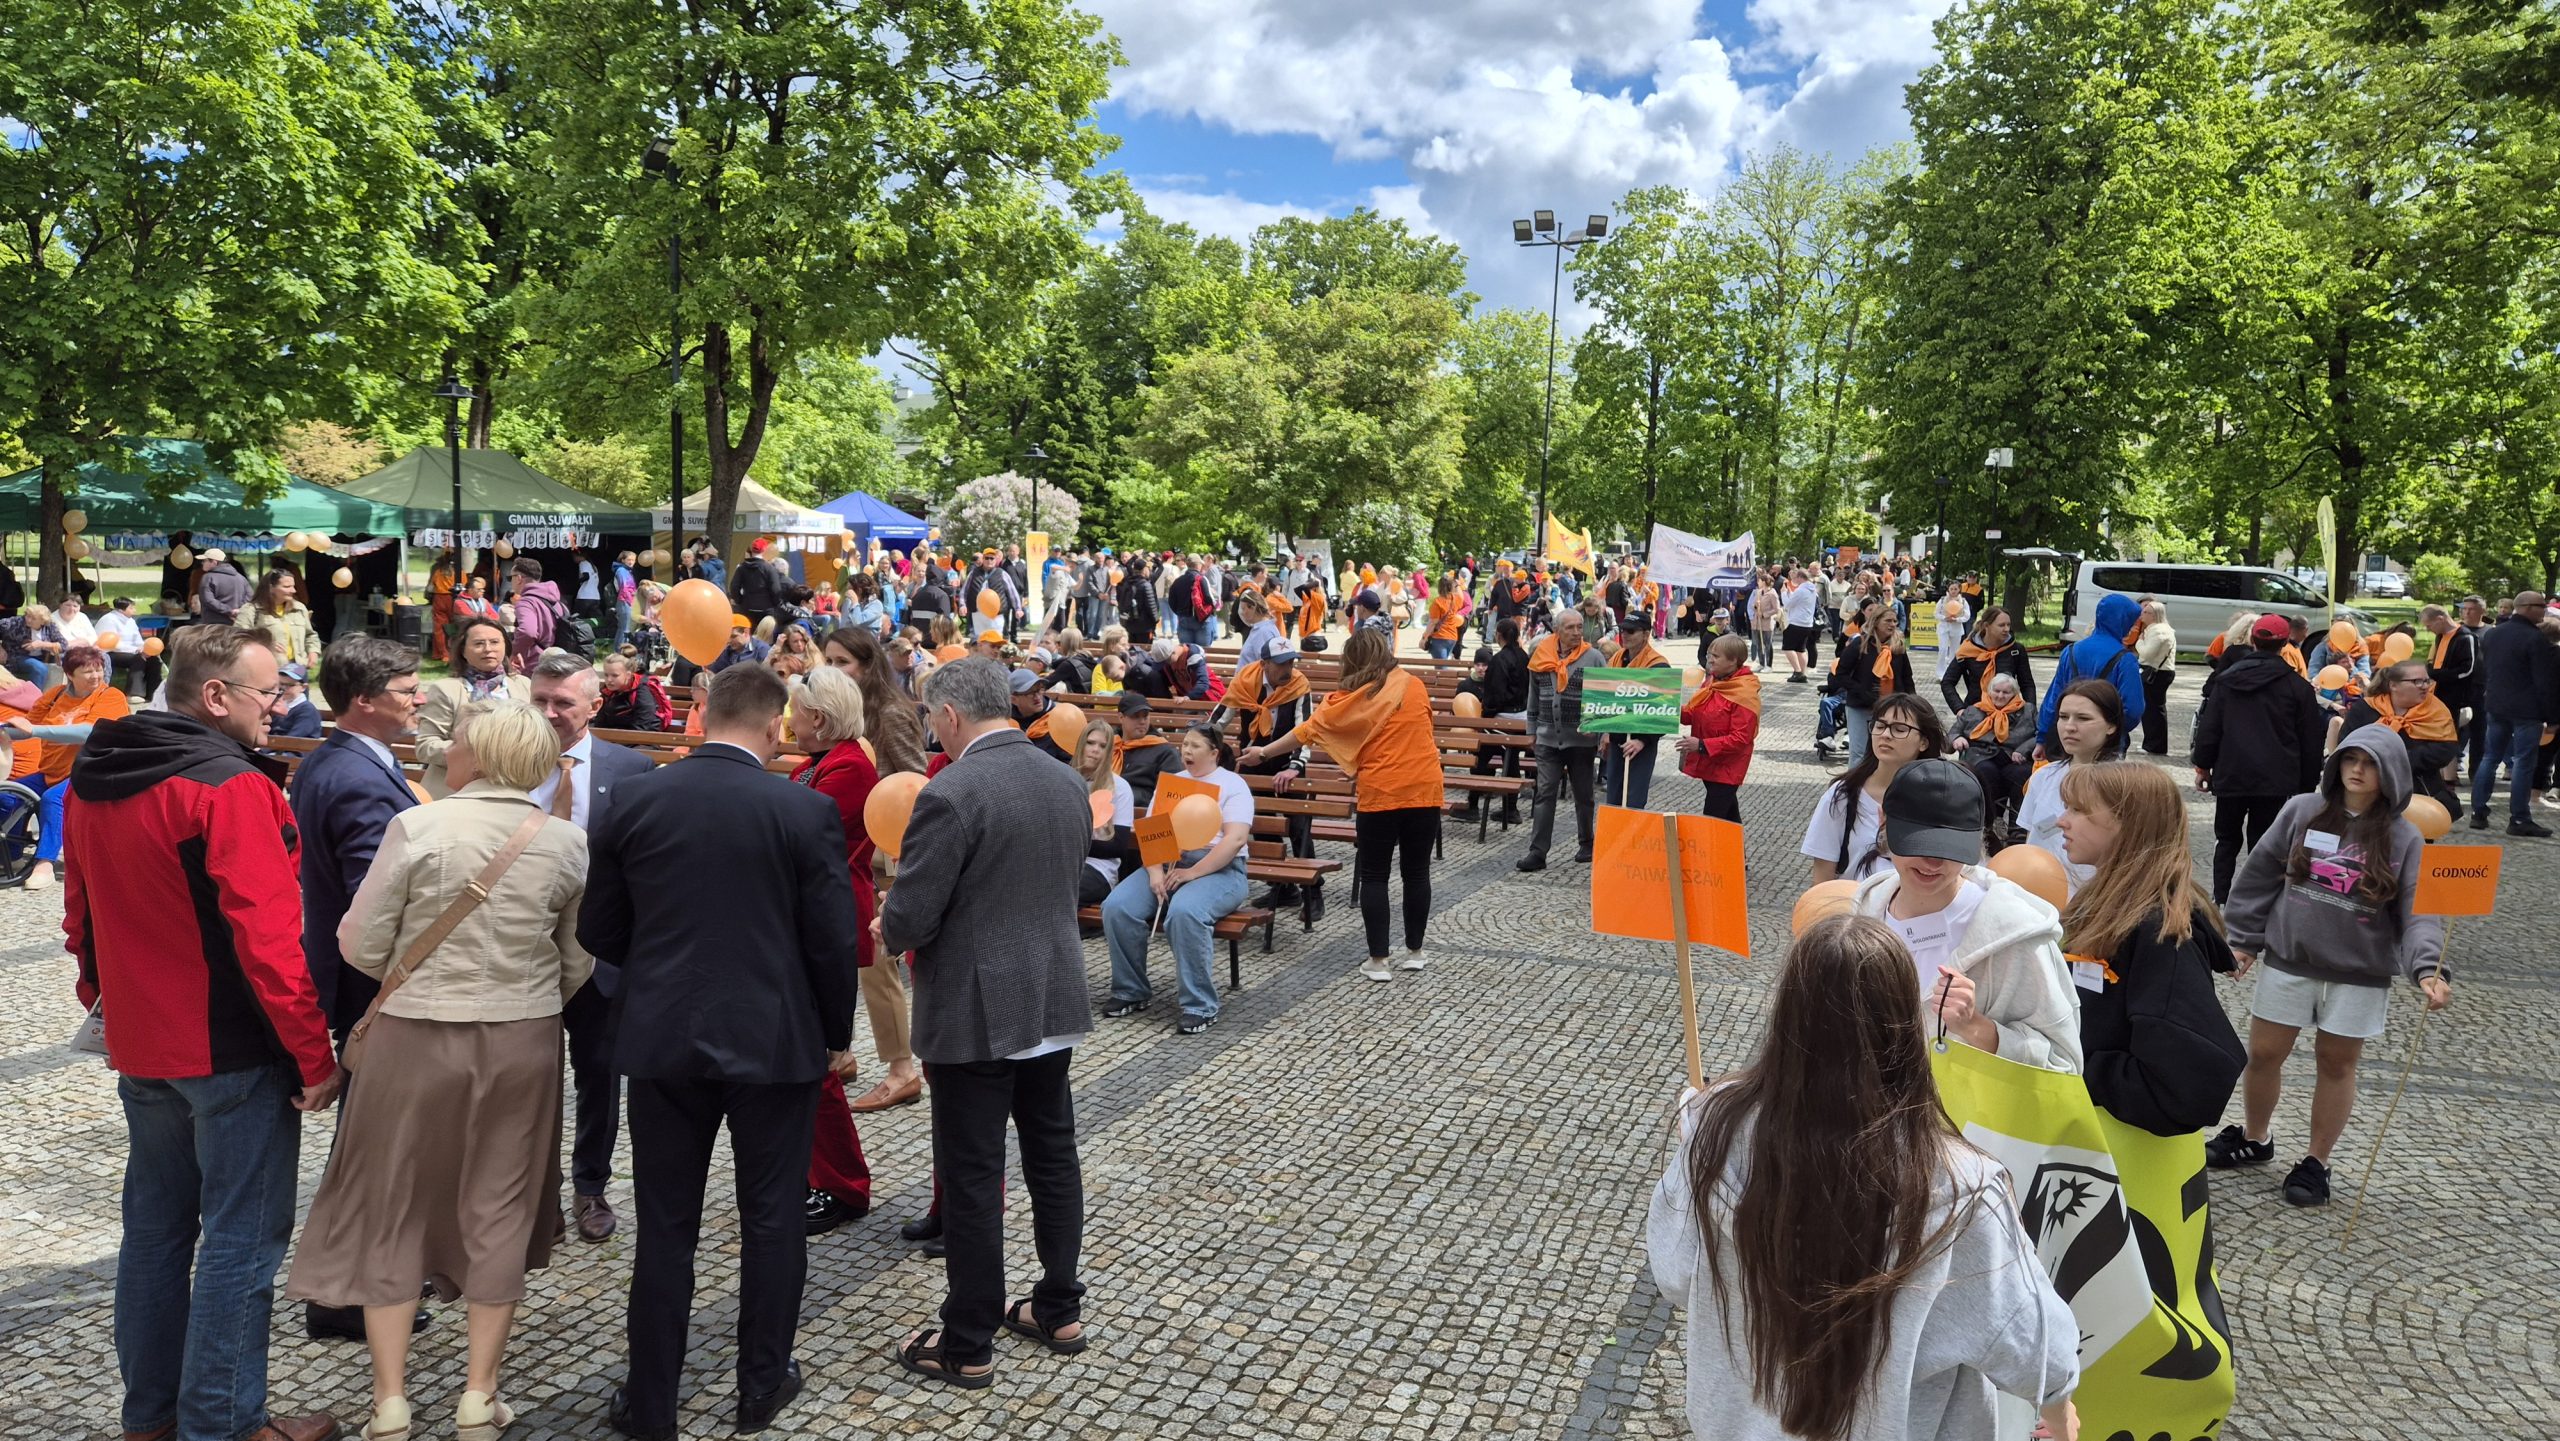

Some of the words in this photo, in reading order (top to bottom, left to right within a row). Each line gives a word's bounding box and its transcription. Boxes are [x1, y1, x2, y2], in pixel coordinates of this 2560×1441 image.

[508, 513, 547, 526] GMINA
[548, 514, 593, 526] SUWAŁKI
[1614, 681, 1650, 697] ŚDS
[1582, 702, 1627, 715] Biała
[1632, 703, 1678, 716] Woda
[1140, 829, 1173, 843] TOLERANCJA
[2432, 864, 2489, 879] GODNOŚĆ
